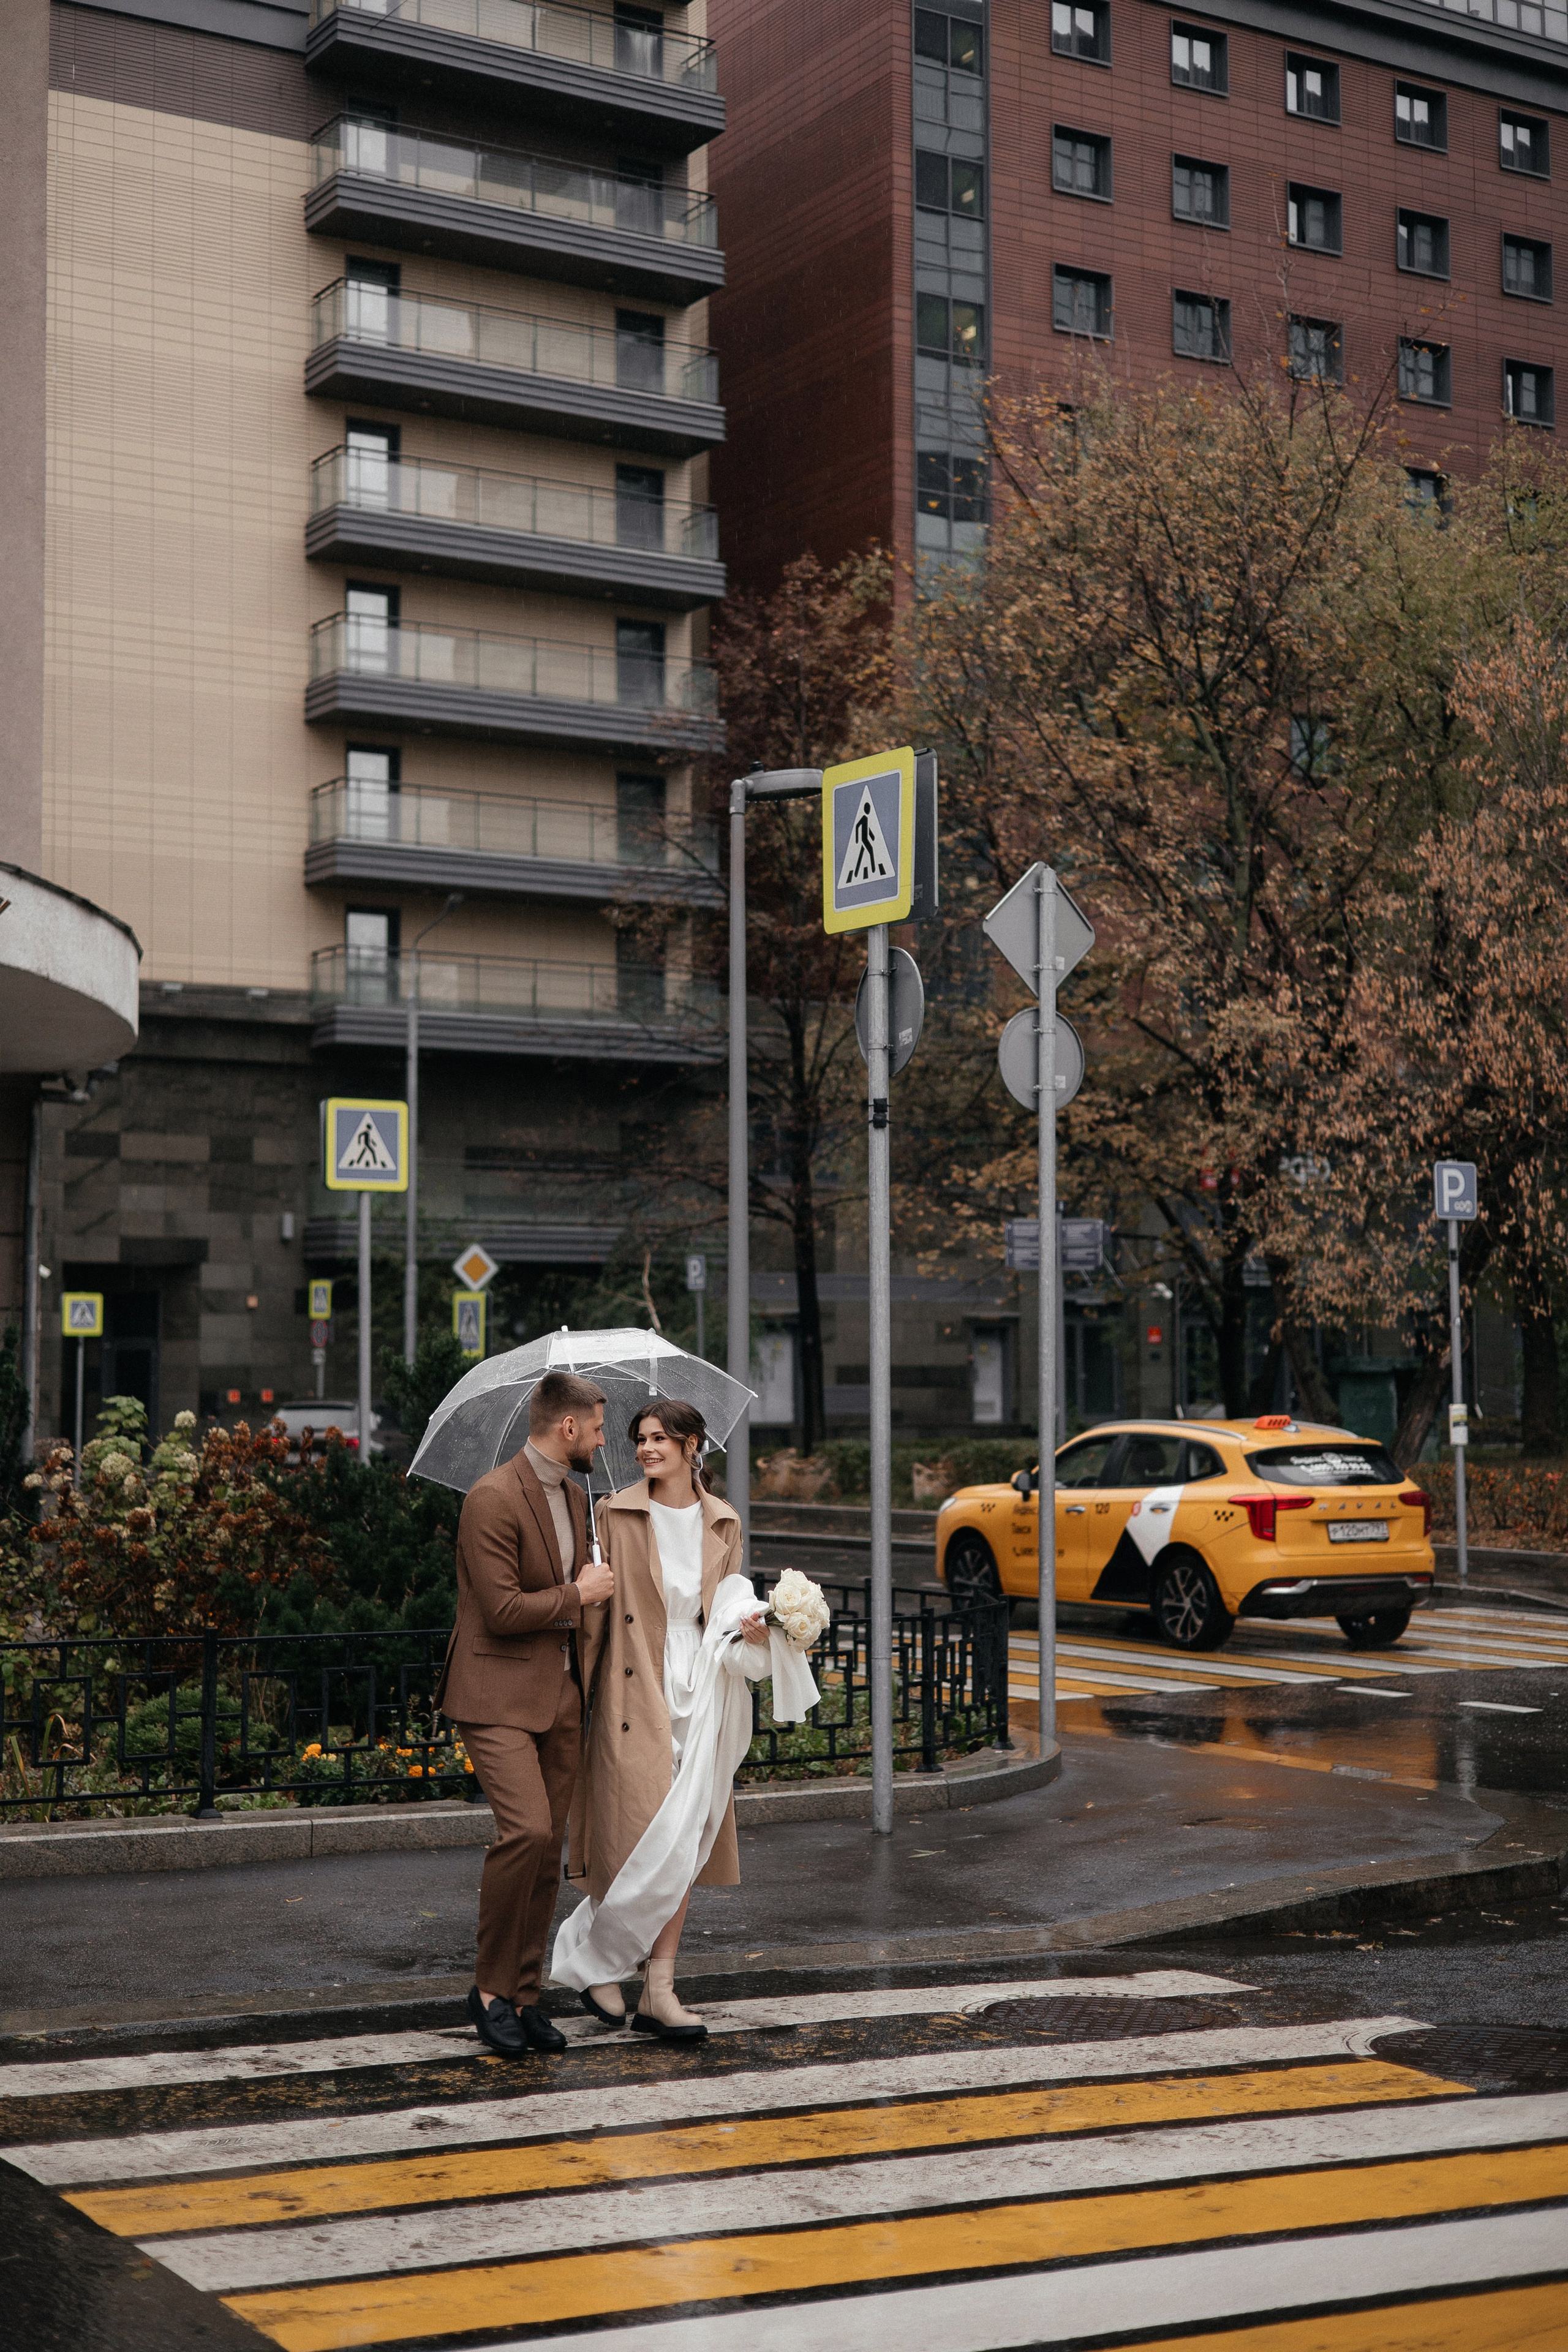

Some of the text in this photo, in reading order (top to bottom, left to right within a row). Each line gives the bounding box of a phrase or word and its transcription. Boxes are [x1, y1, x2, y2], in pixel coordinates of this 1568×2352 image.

[1442, 1167, 1465, 1212] P
[688, 1259, 701, 1284] P
[1319, 1501, 1396, 1510] HAVAL
